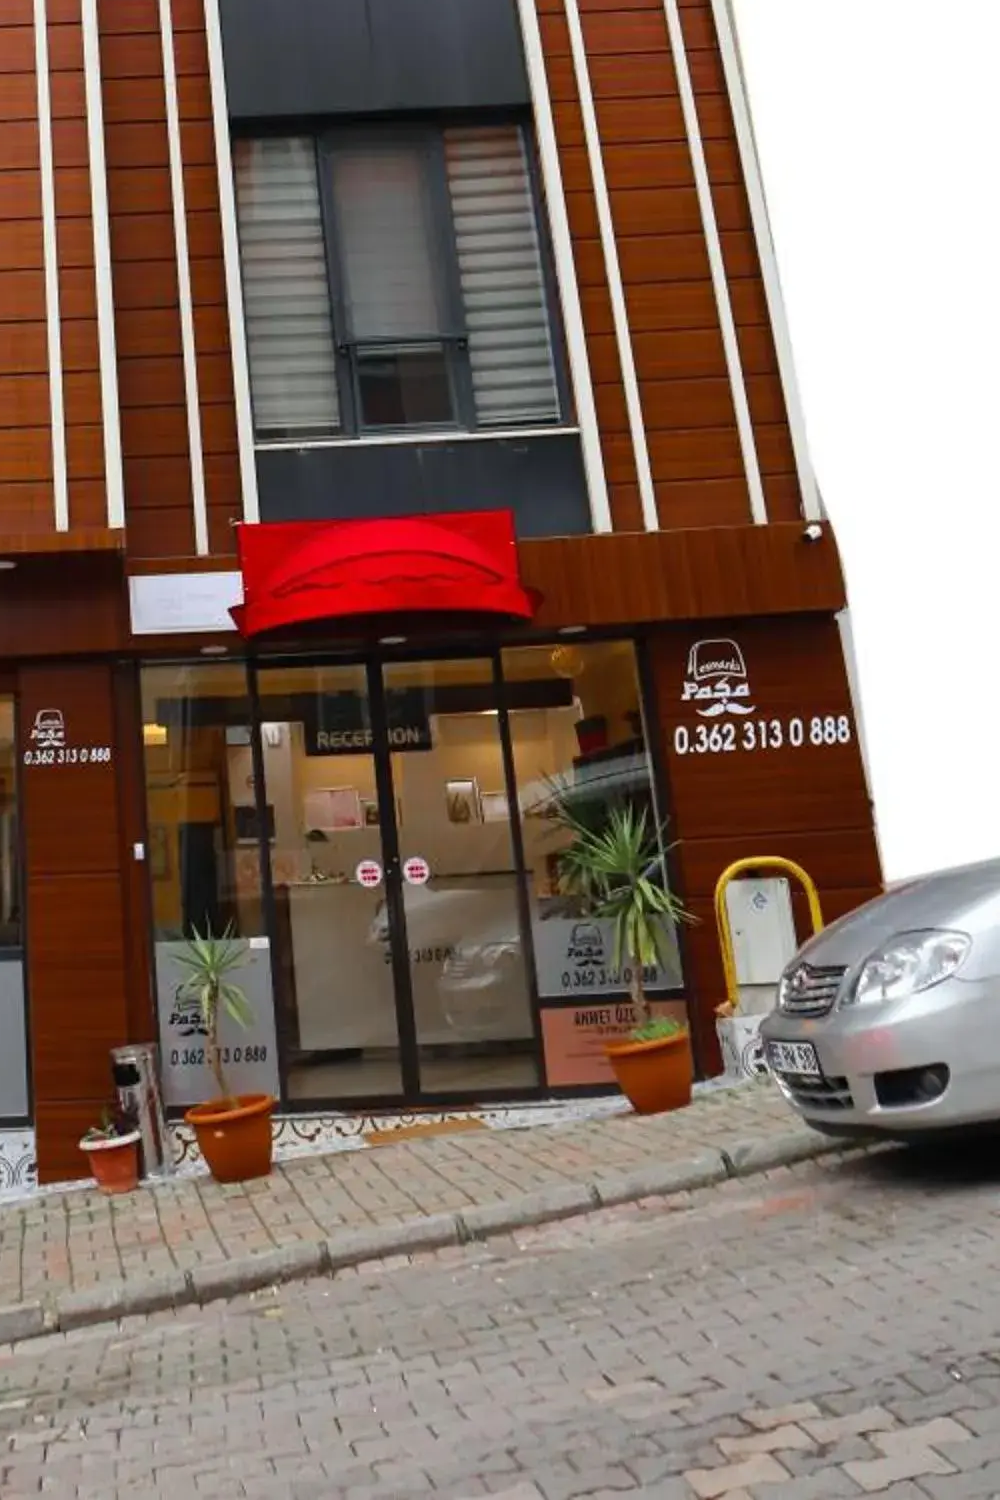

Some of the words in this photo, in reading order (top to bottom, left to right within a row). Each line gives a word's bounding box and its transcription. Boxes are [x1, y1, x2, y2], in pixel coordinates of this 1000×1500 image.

[316, 727, 420, 750] RECEPION
[674, 723, 736, 755] 0.362
[742, 719, 783, 750] 313
[789, 717, 804, 747] 0
[809, 715, 851, 746] 888
[23, 750, 54, 765] 0.362
[57, 749, 78, 764] 313
[79, 747, 88, 762] 0
[233, 1047, 242, 1062] 0
[244, 1046, 267, 1062] 888
